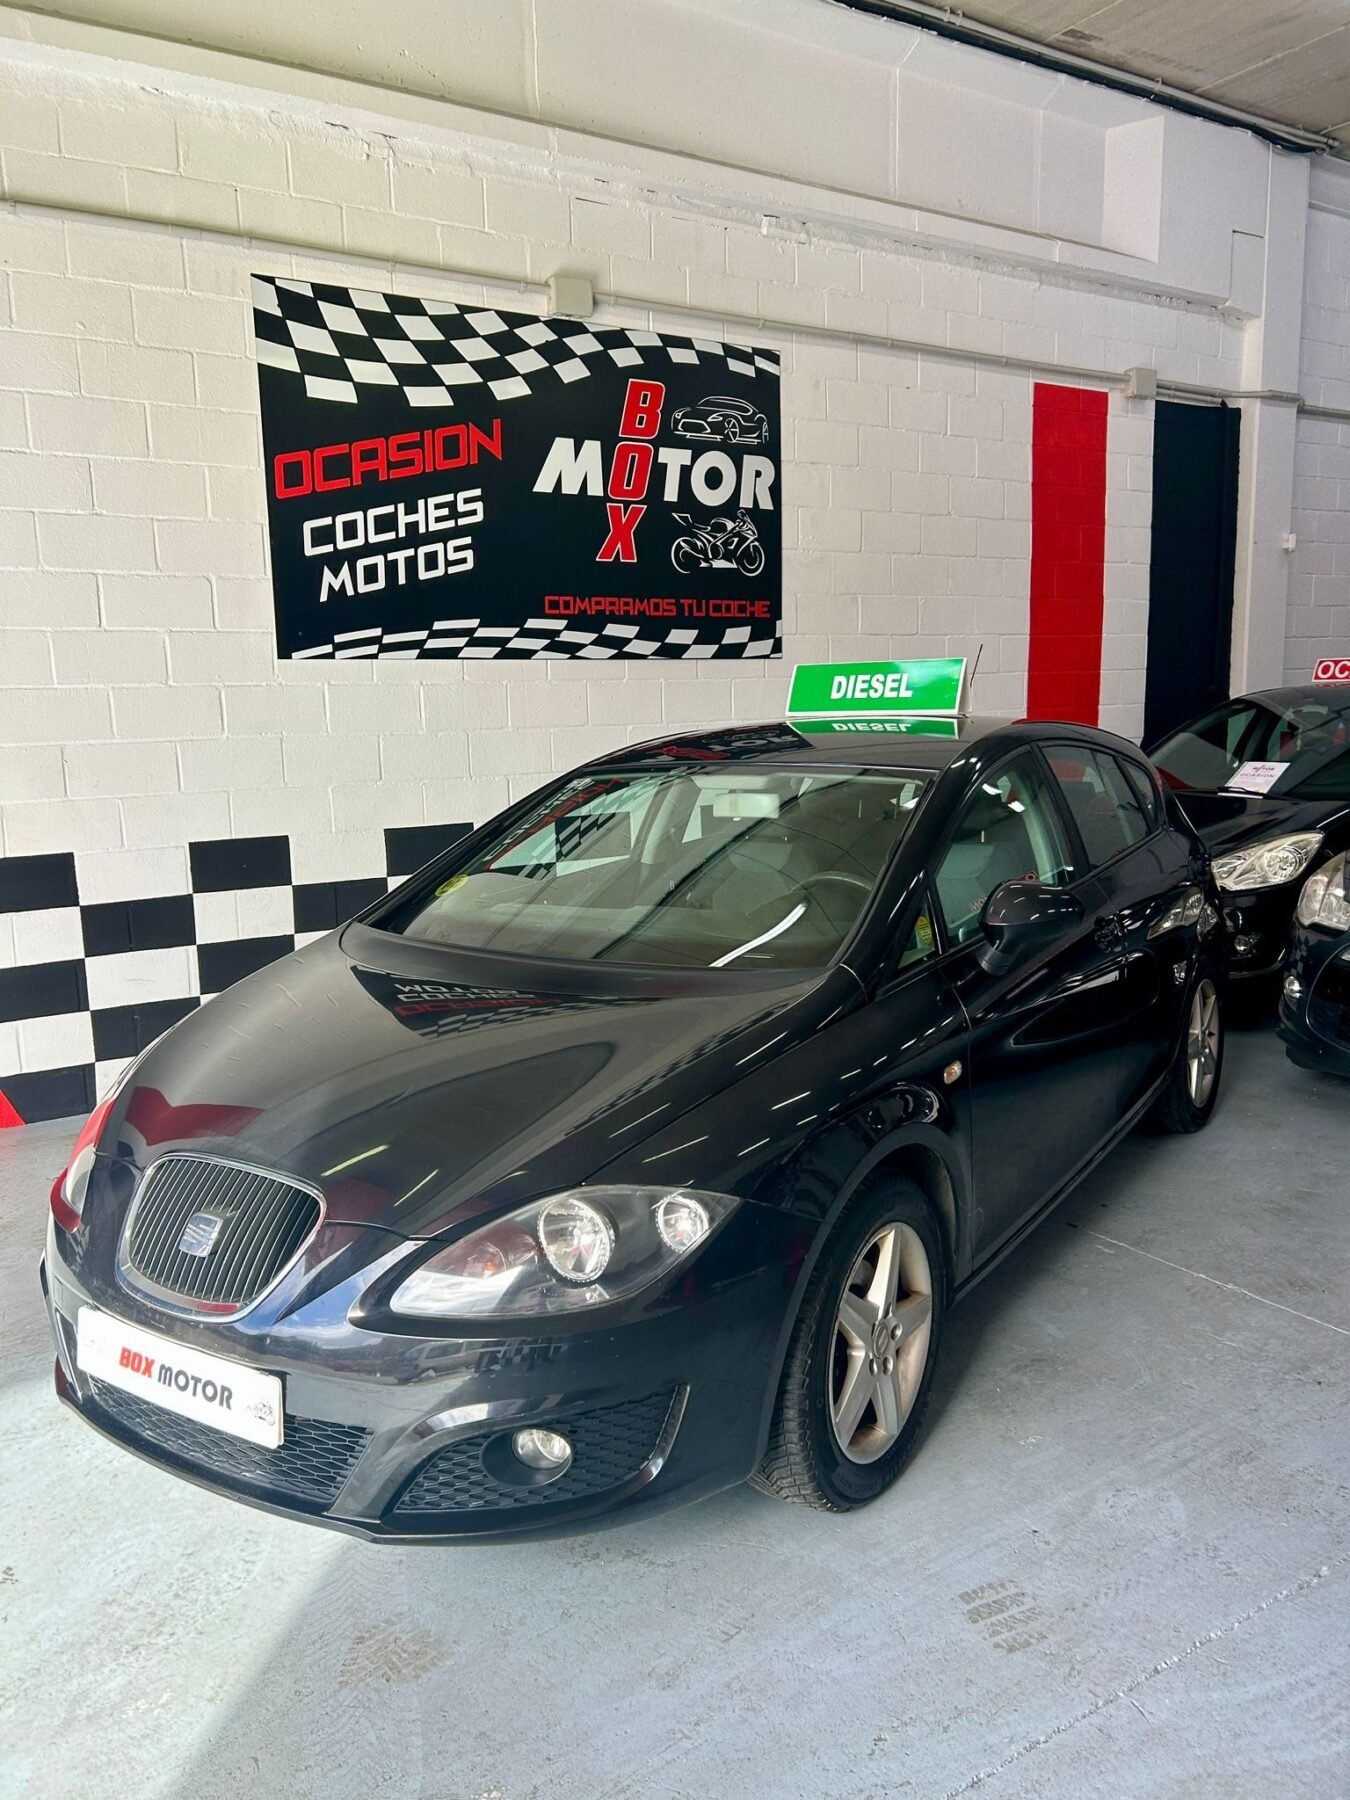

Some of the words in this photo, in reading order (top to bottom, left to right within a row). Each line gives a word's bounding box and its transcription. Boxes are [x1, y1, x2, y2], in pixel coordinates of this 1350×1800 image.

[274, 418, 503, 499] OCASION
[596, 378, 666, 563] BOX
[302, 488, 484, 557] COCHES
[319, 536, 474, 603] MOTOS
[544, 595, 677, 617] COMPRAMOS
[679, 598, 706, 618] TU
[708, 599, 771, 618] COCHE
[830, 673, 912, 700] DIESEL
[118, 1346, 156, 1378] BOX
[157, 1363, 233, 1410] MOTOR
